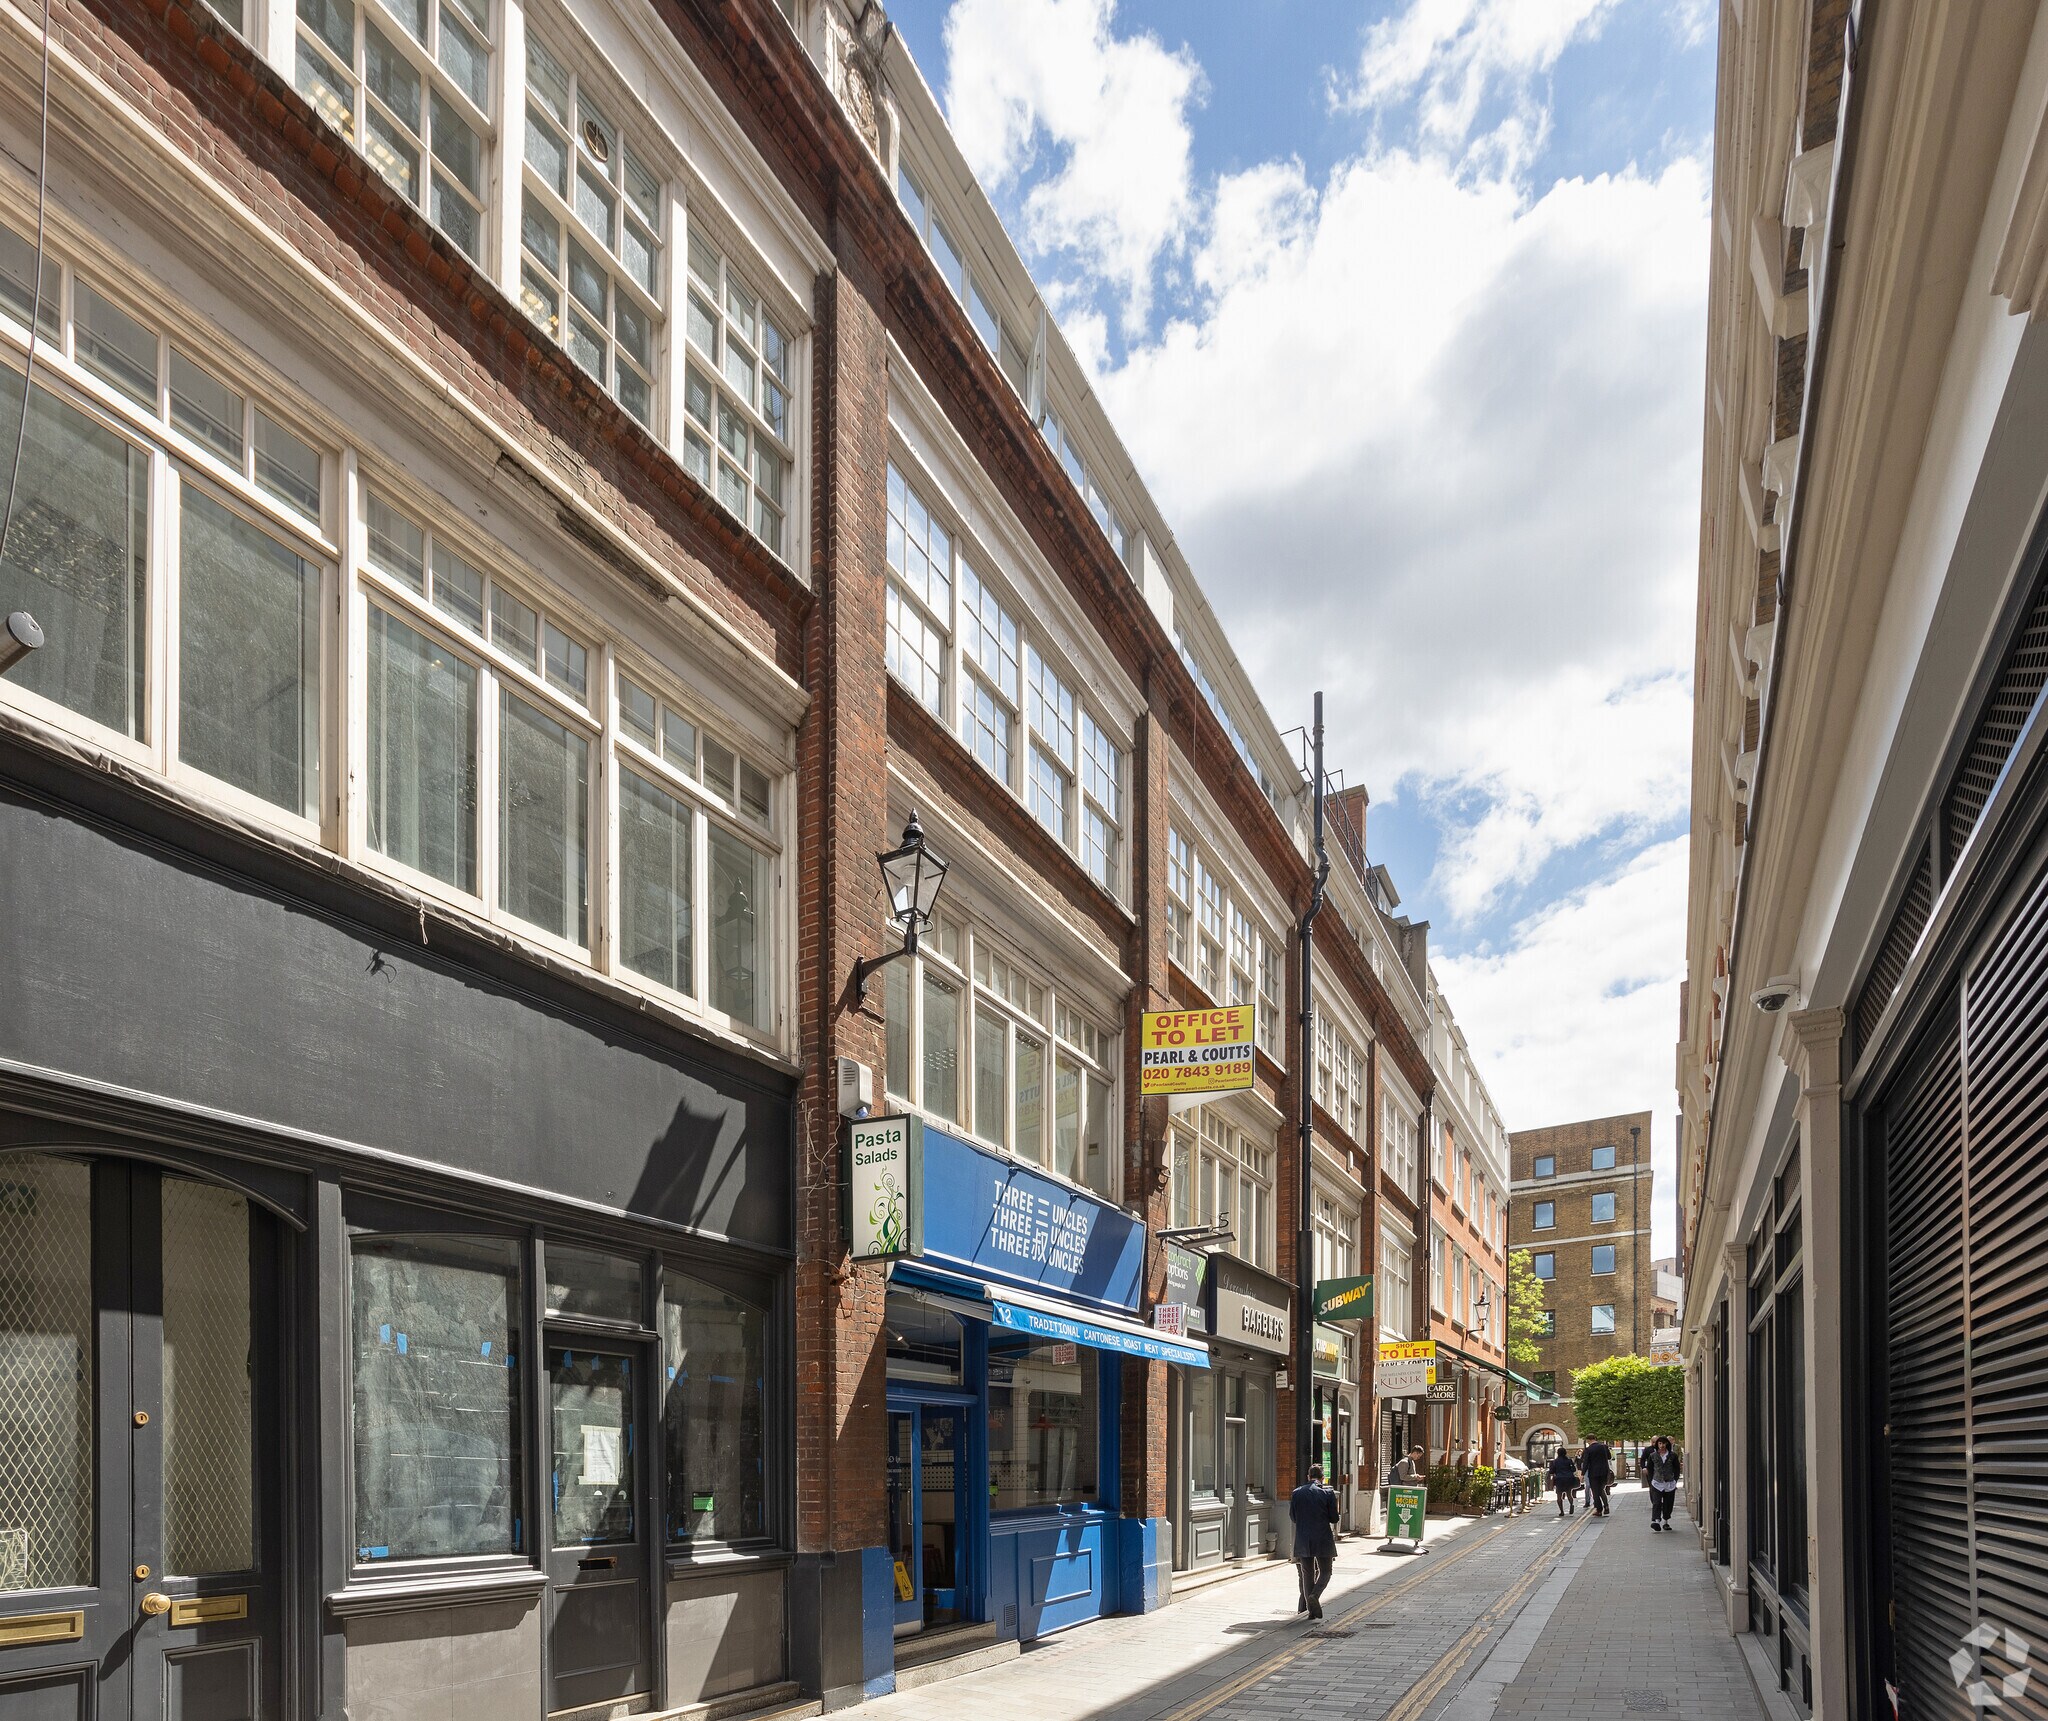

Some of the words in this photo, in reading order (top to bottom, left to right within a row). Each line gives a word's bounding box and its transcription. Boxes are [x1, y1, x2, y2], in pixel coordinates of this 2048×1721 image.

[1156, 1010, 1240, 1029] OFFICE
[1151, 1030, 1186, 1046] TO
[1195, 1025, 1244, 1044] LET
[1144, 1050, 1185, 1065] PEARL
[1188, 1049, 1198, 1063] &
[1202, 1044, 1250, 1062] COUTTS
[1143, 1068, 1170, 1080] 020
[1174, 1065, 1210, 1079] 7843
[1215, 1062, 1251, 1076] 9189
[855, 1129, 901, 1149] Pasta
[855, 1148, 898, 1166] Salads
[994, 1180, 1034, 1214] THREE
[1052, 1204, 1088, 1235] UNCLES
[992, 1203, 1033, 1236] THREE
[1050, 1226, 1086, 1255] UNCLES
[990, 1226, 1031, 1259] THREE
[1048, 1247, 1084, 1275] UNCLES
[1167, 1263, 1189, 1281] options
[1319, 1281, 1371, 1315] SUBWAY
[999, 1307, 1013, 1324] 12
[1242, 1304, 1285, 1341] BARBERS
[1029, 1315, 1081, 1338] TRADITIONAL
[1083, 1329, 1121, 1346] CANTONESE
[1123, 1338, 1142, 1351] ROAST
[1144, 1343, 1160, 1355] MEAT
[1161, 1346, 1197, 1362] SPECIALISTS
[1381, 1350, 1399, 1359] TO
[1404, 1348, 1429, 1359] LET
[1380, 1375, 1422, 1386] KLINIK
[1428, 1384, 1454, 1392] CARDS
[1426, 1391, 1456, 1399] GALORE
[1395, 1497, 1419, 1505] MORE
